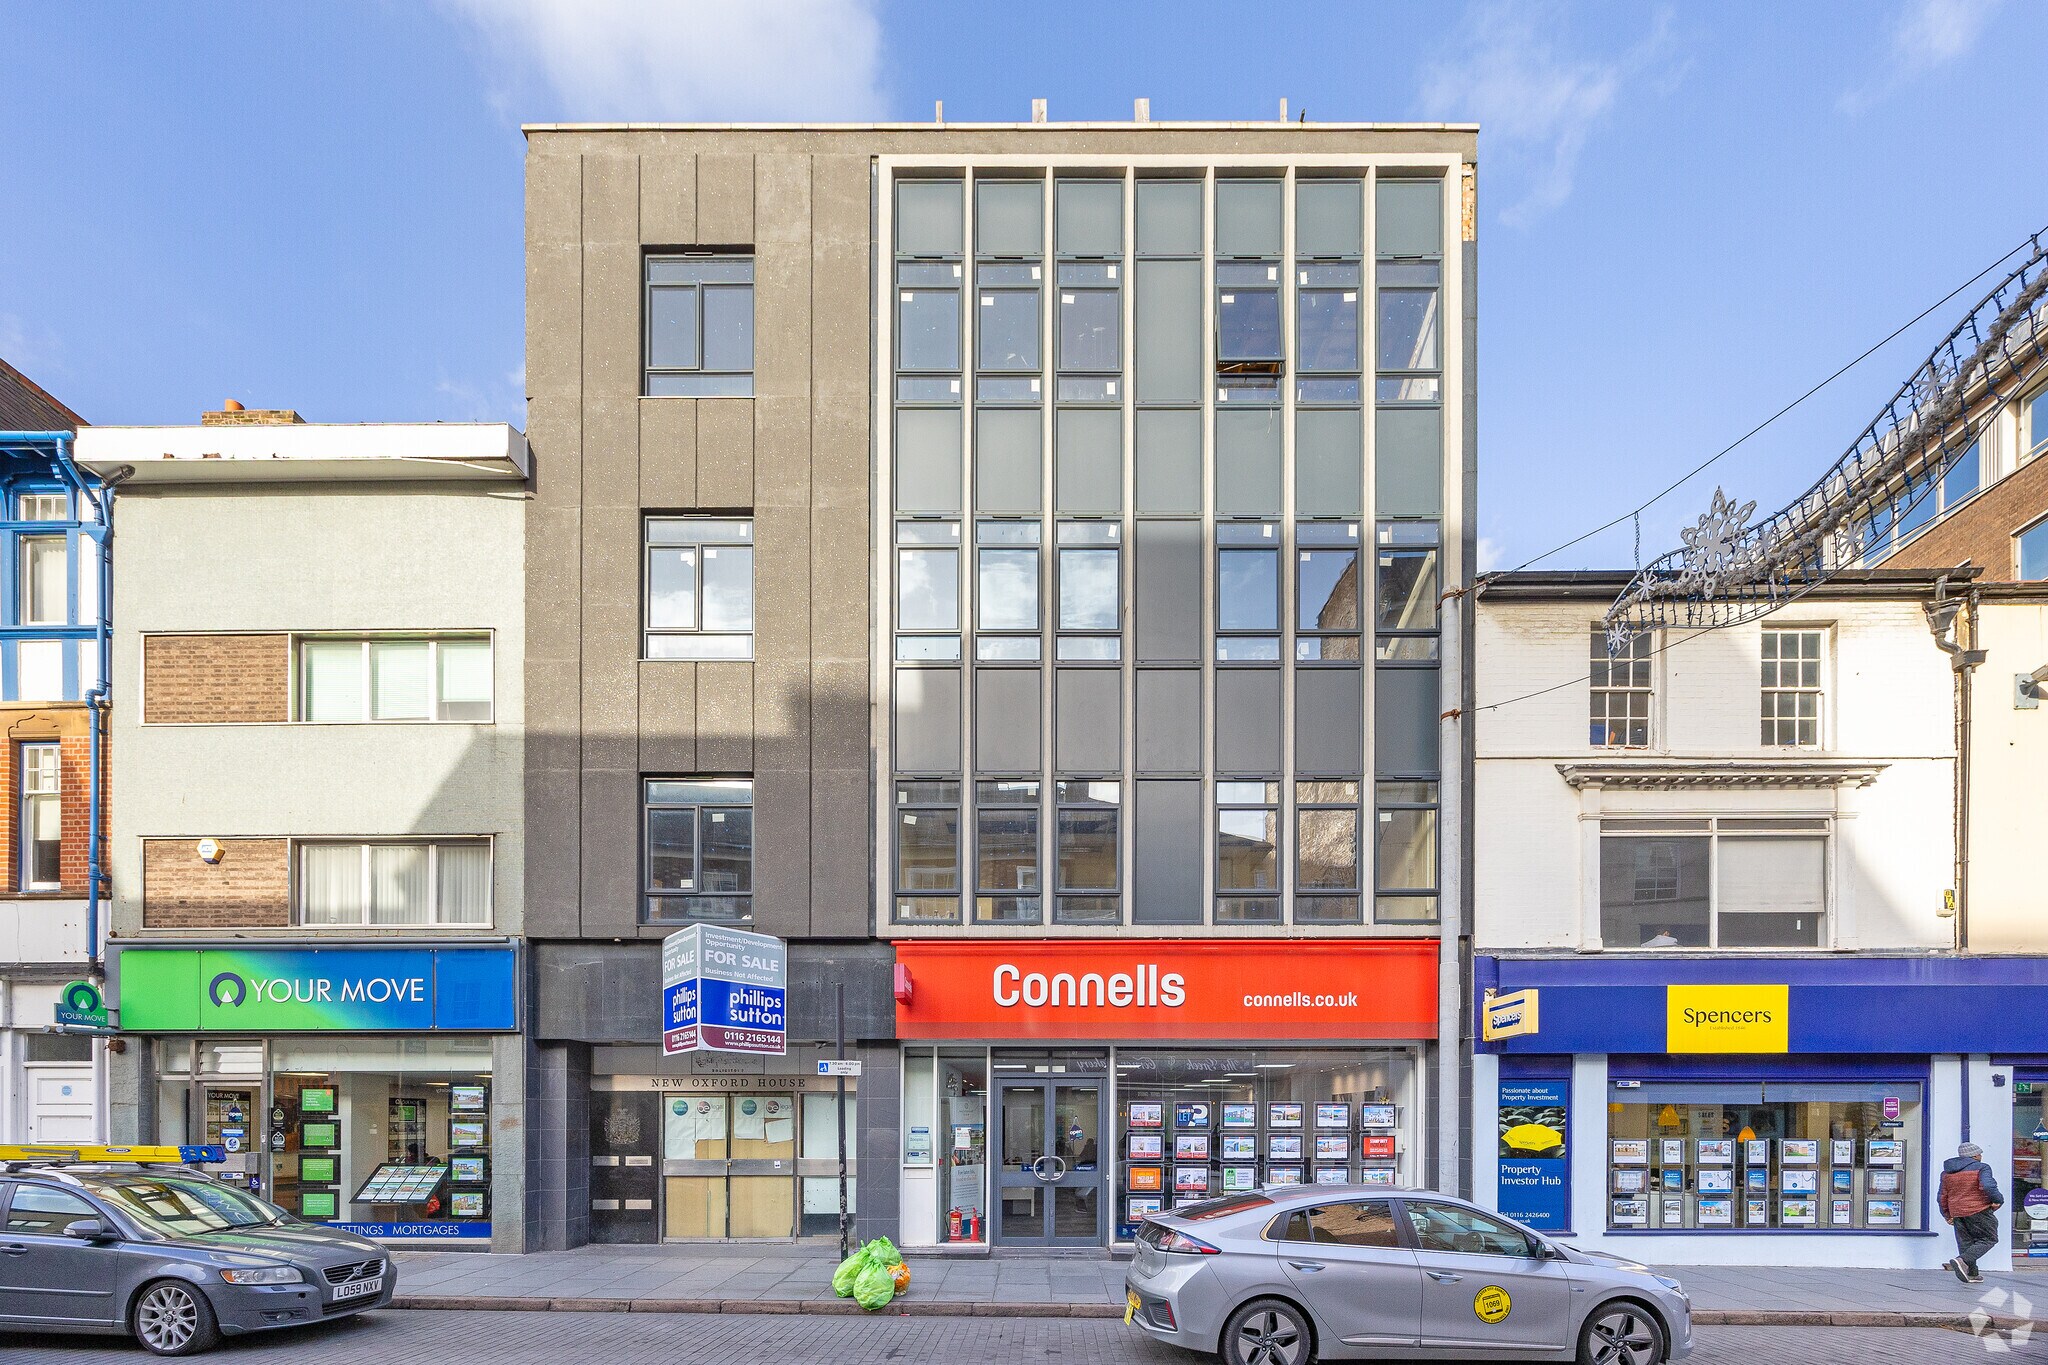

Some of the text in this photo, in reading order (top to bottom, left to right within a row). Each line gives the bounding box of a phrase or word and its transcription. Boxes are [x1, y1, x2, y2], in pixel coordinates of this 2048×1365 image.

[706, 932, 783, 951] Investment/Development
[706, 939, 746, 951] Opportunity
[665, 950, 695, 973] FOR SALE
[705, 950, 779, 972] FOR SALE
[705, 967, 774, 982] Business Not Affected
[251, 978, 424, 1003] YOUR MOVE
[993, 964, 1186, 1007] Connells
[672, 986, 696, 1011] phillips
[730, 988, 781, 1012] phillips
[1243, 992, 1358, 1007] connells.co.uk
[61, 1012, 106, 1022] YOUR MOVE
[673, 1006, 696, 1023] sutton
[730, 1007, 782, 1025] sutton
[1492, 1011, 1522, 1029] Spencers
[1683, 1008, 1772, 1027] Spencers
[724, 1031, 781, 1043] 0116 2165144
[652, 1078, 805, 1088] NEW OXFORD HOUSE
[1501, 1165, 1541, 1176] Property
[1501, 1176, 1561, 1186] Investor Hub
[393, 1225, 460, 1235] MORTGAGES
[337, 1280, 379, 1299] LO59 NXV
[1486, 1300, 1500, 1308] 1069
